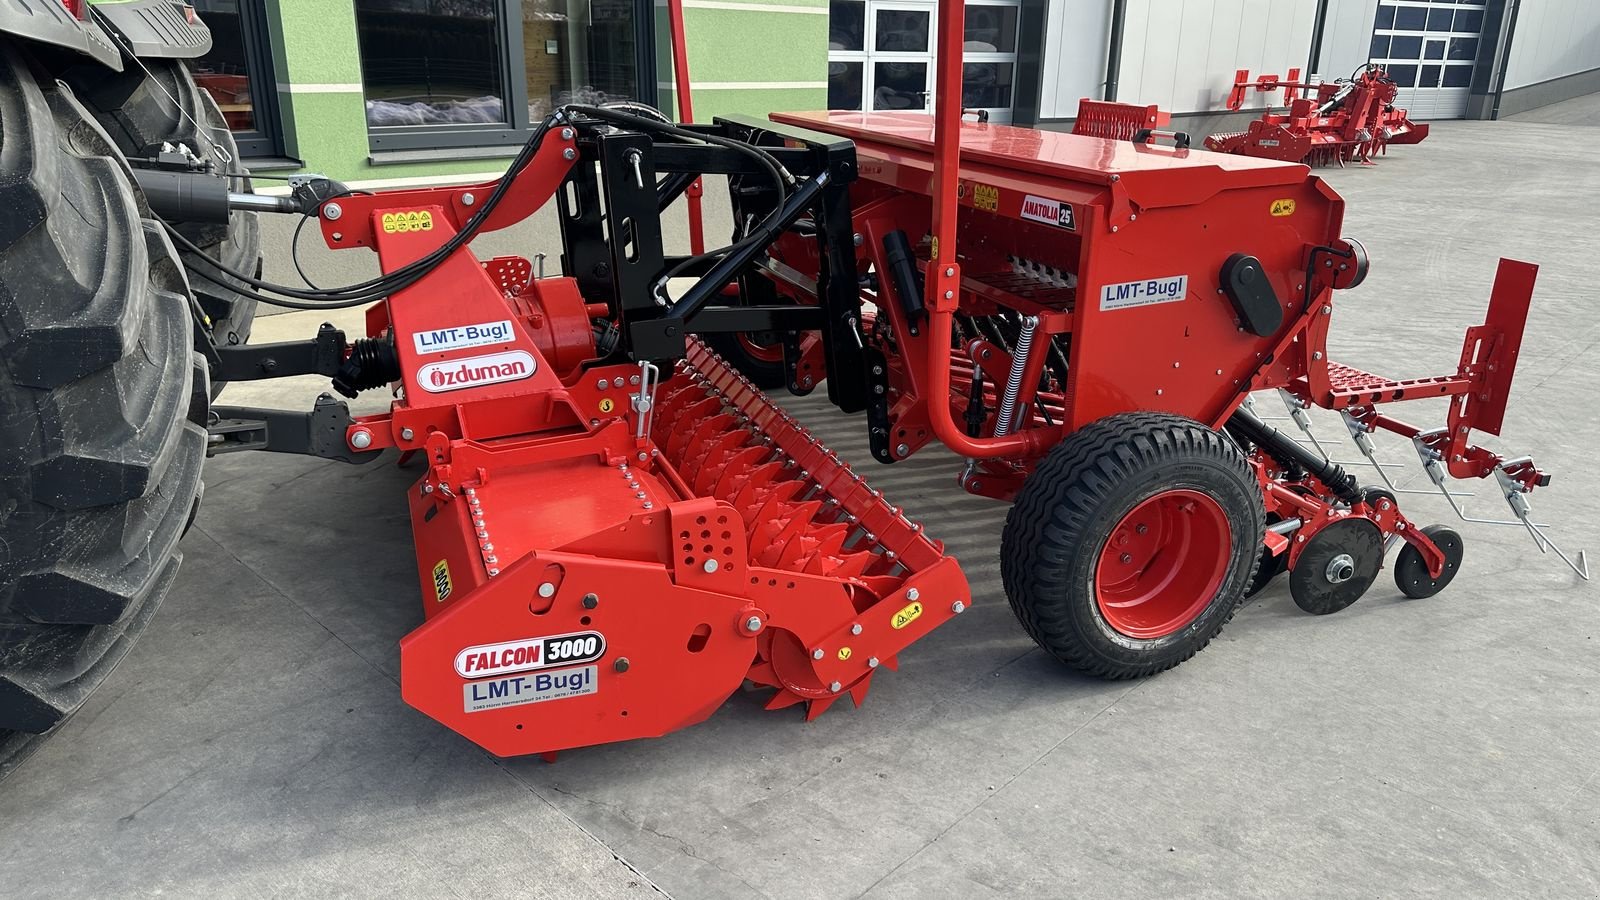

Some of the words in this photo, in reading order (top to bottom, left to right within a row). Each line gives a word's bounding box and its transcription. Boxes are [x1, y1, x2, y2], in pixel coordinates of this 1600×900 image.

[1023, 200, 1058, 221] ANATOLIA
[1060, 208, 1071, 224] 25
[1106, 277, 1183, 302] LMT-Bugl
[420, 322, 508, 346] LMT-Bugl
[430, 361, 526, 387] Özduman
[465, 645, 541, 672] FALCON
[548, 637, 597, 660] 3000
[472, 668, 590, 701] LMT-Bugl
